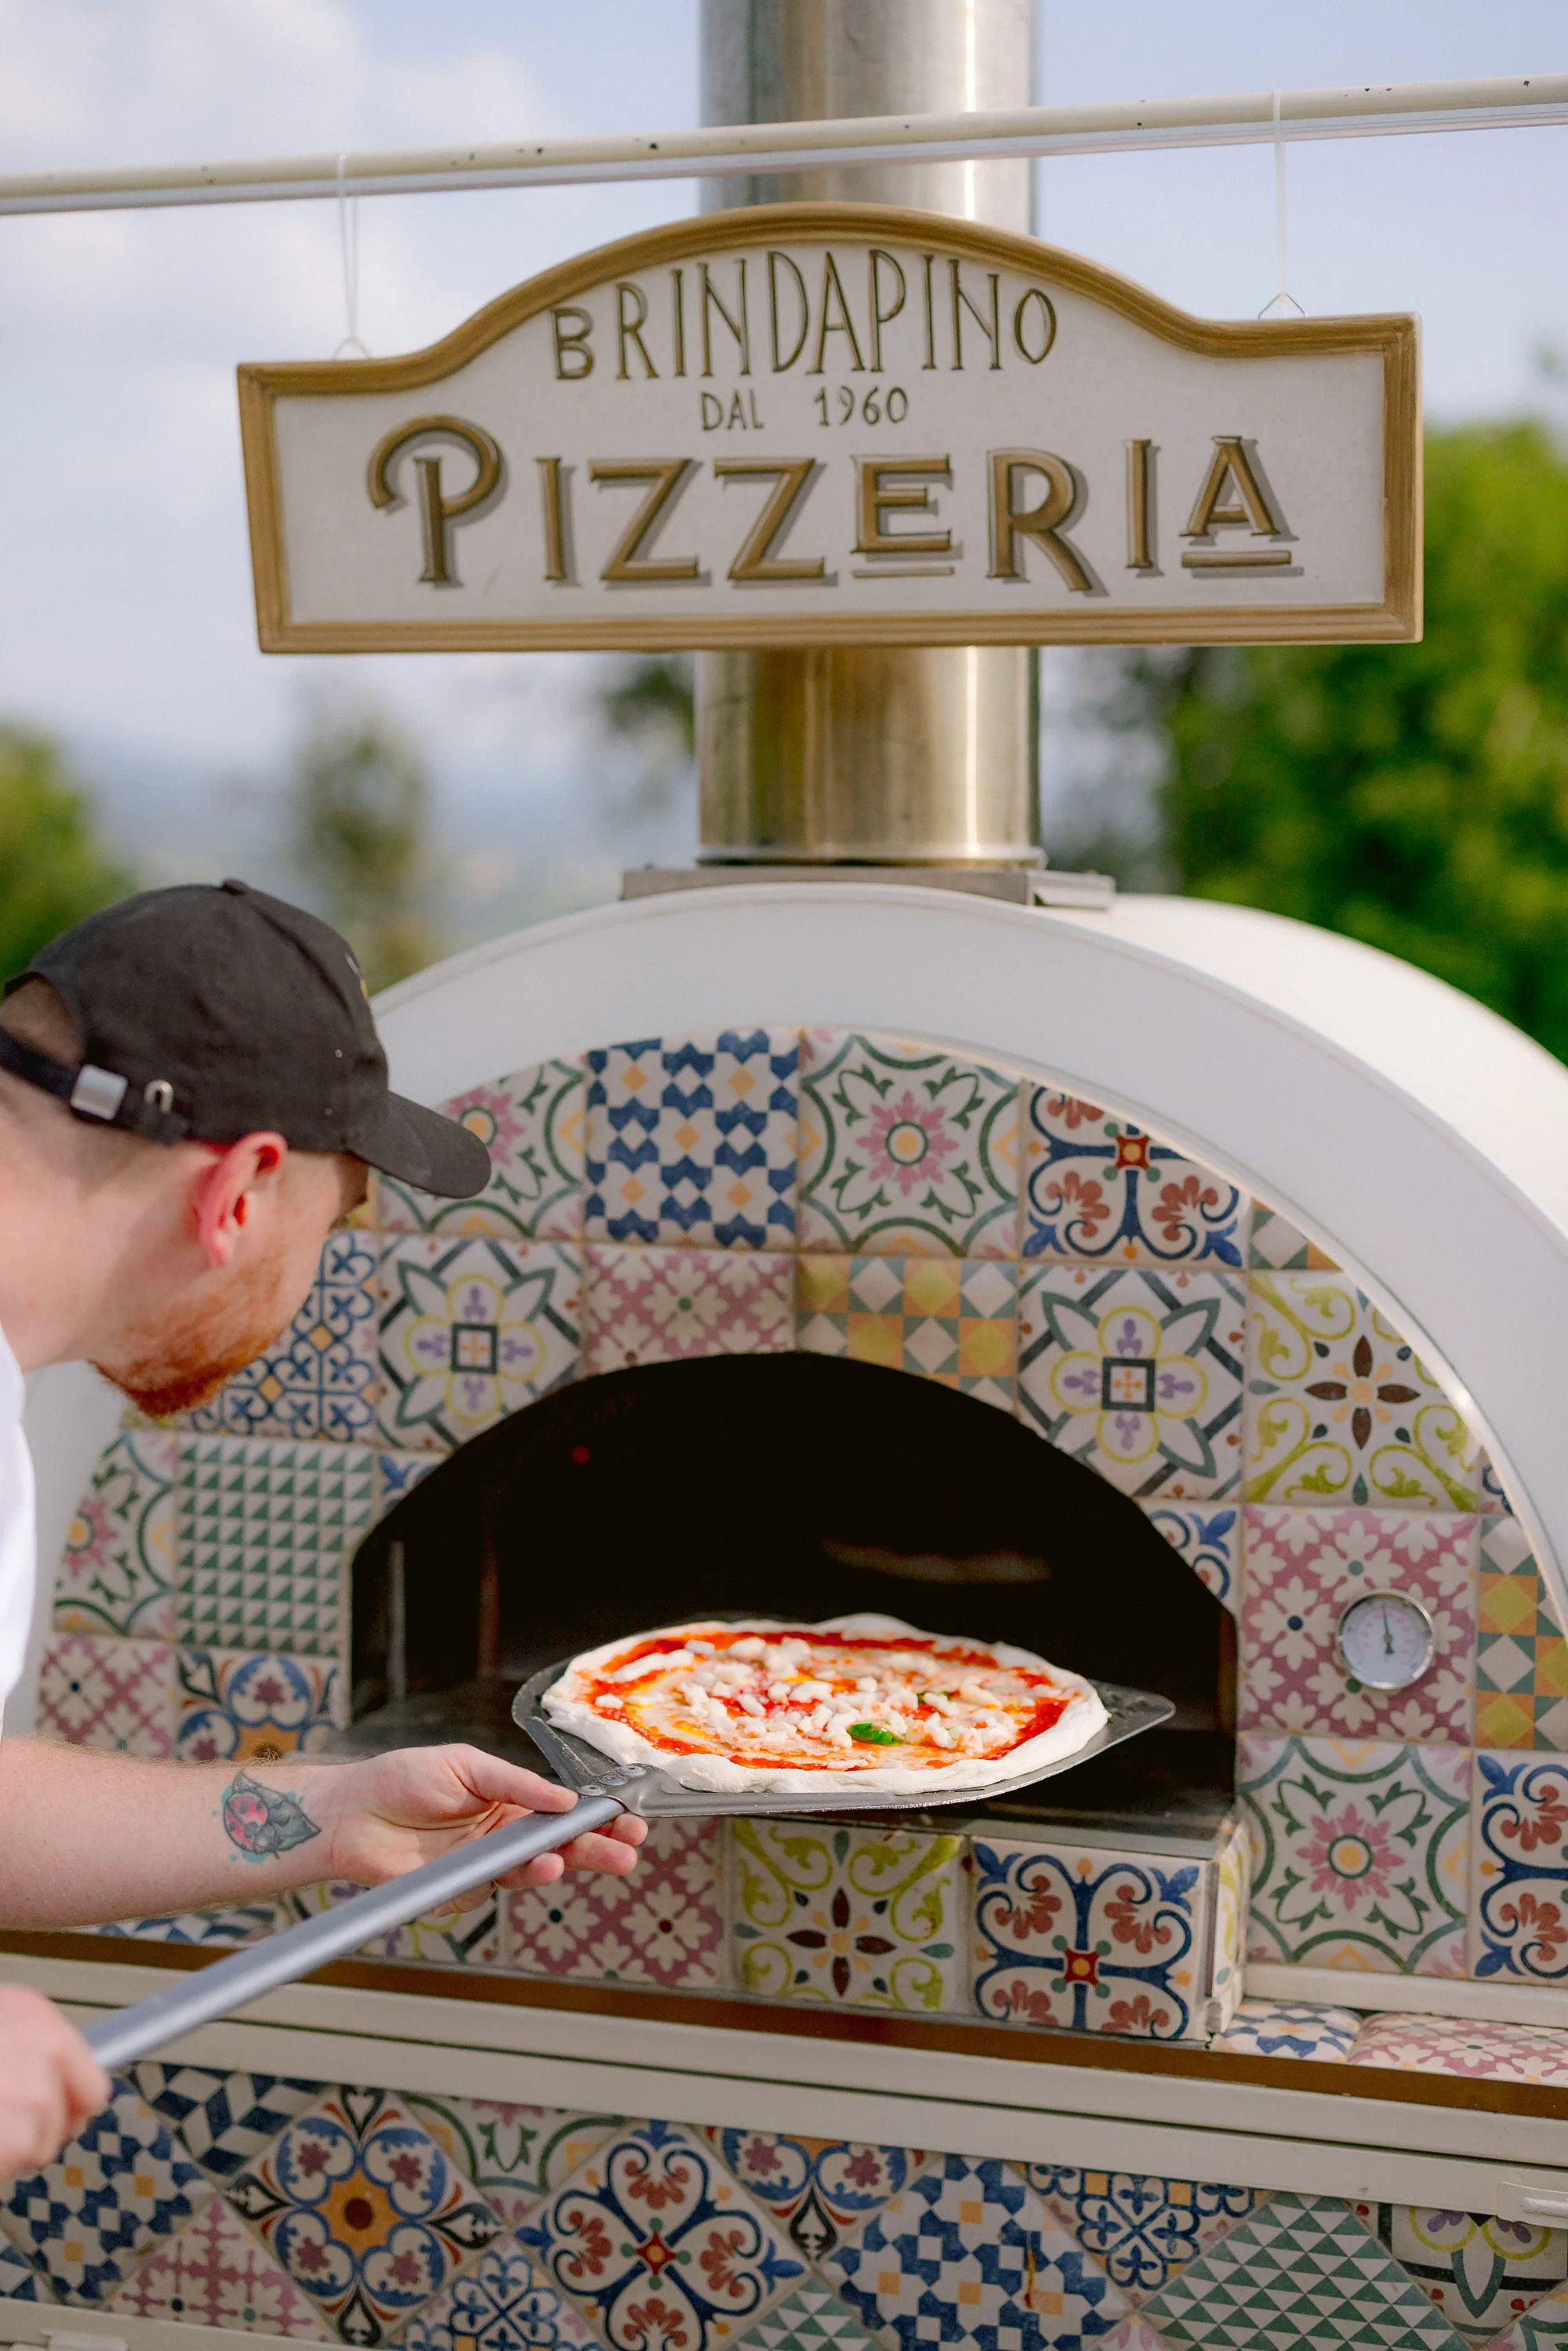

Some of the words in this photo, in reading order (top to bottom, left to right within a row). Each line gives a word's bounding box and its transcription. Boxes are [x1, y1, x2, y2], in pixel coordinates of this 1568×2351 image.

[551, 249, 1058, 380] BRINDAPINO
[701, 387, 765, 431] DAL
[812, 384, 909, 427] 1960
[366, 414, 1300, 596] PIZZERIA
